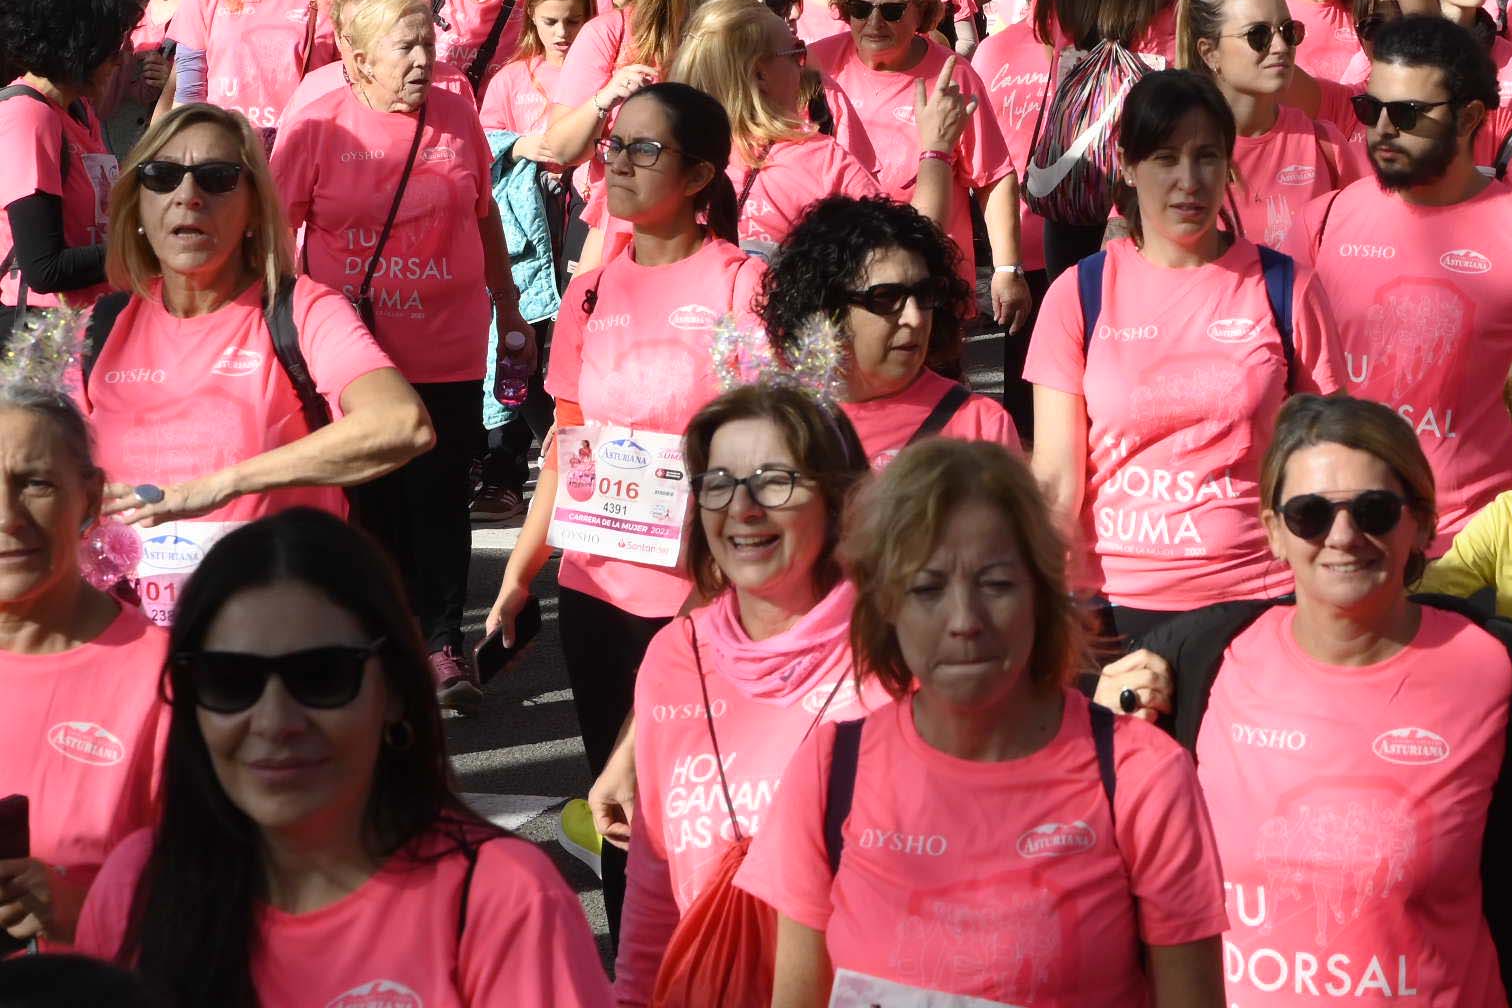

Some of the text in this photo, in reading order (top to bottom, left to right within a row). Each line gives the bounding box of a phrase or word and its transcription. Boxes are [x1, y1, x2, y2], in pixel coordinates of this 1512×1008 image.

[341, 150, 385, 162] OYSHO
[345, 229, 376, 250] TU
[1339, 244, 1395, 259] OYSHO
[344, 256, 453, 280] DORSAL
[1443, 256, 1489, 271] ASTURIANA
[104, 369, 167, 384] OYSHO
[604, 447, 647, 465] ASTURIANA
[599, 477, 639, 500] 016
[1101, 467, 1241, 503] DORSAL
[603, 502, 627, 515] 4391
[568, 513, 601, 525] CARRERA
[602, 517, 611, 527] DE
[612, 520, 620, 528] LA
[621, 522, 648, 534] MUJER
[1099, 507, 1202, 545] SUMA
[55, 728, 118, 760] ASTURIANA
[1232, 723, 1307, 751] OYSHO
[1379, 736, 1445, 757] ASTURIANA
[672, 752, 737, 789] HOY
[859, 828, 948, 856] OYSHO
[1022, 830, 1094, 853] ASTURIANA
[1225, 941, 1417, 997] DORSAL
